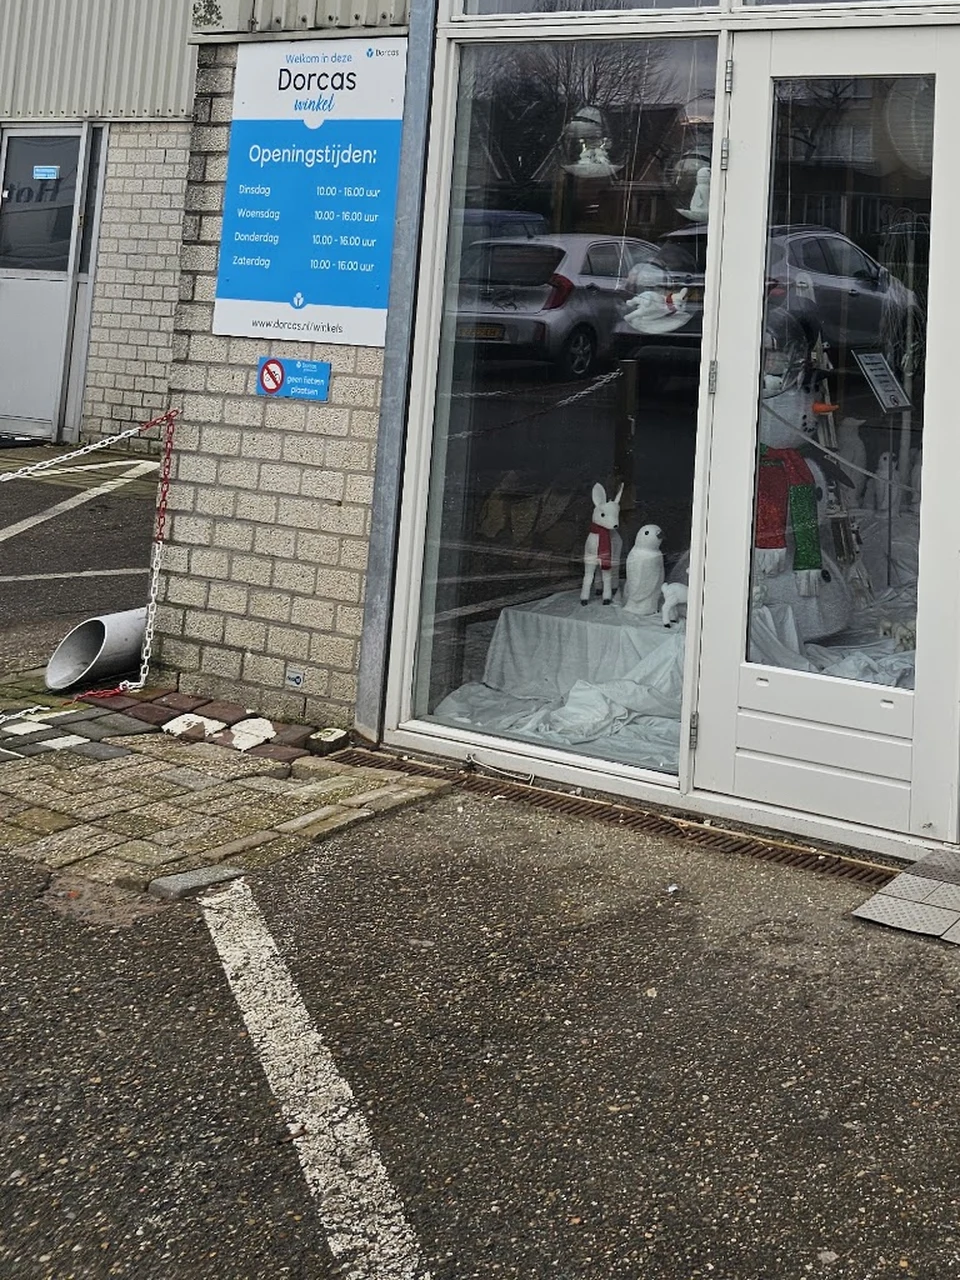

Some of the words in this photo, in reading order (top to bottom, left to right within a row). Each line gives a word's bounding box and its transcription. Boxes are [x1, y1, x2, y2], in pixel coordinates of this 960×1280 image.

[285, 53, 320, 63] Welkom
[321, 53, 330, 63] in
[330, 53, 352, 63] deze
[375, 48, 399, 57] Dorcas
[278, 68, 357, 91] Dorcas
[293, 93, 335, 112] winkel
[249, 143, 377, 168] Openingstijden:
[239, 184, 271, 197] Dinsdag
[316, 185, 337, 197] 10.00
[365, 188, 381, 198] uur
[237, 207, 281, 221] Woensdag
[314, 210, 334, 222] 10.00
[342, 211, 363, 223] 16.00
[363, 214, 379, 223] uur
[234, 231, 280, 245] Donderdag
[312, 234, 333, 246] 10.00
[339, 235, 361, 247] 16.00
[361, 238, 377, 247] uur
[232, 255, 271, 269] Zaterdag
[310, 259, 331, 270] 10.00
[337, 260, 359, 271] 16.00
[359, 263, 375, 272] uur
[251, 319, 344, 334] www.dorcas.nl/winkels
[290, 387, 318, 395] plaatsen
